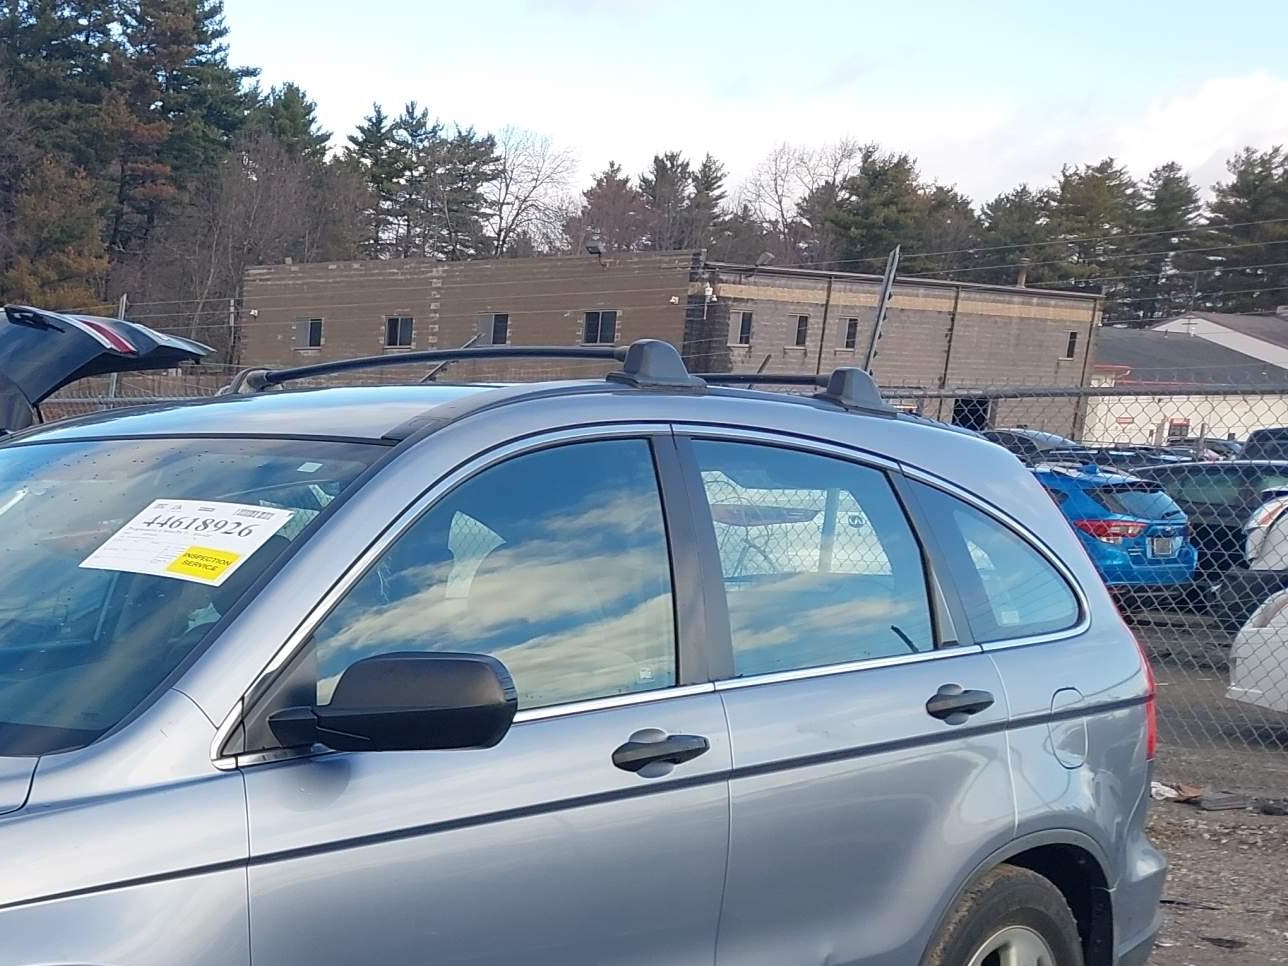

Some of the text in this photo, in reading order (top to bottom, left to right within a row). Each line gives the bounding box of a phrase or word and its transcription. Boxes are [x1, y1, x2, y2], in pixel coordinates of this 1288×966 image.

[143, 514, 260, 537] 44618926
[181, 559, 219, 572] SERVICE
[183, 552, 233, 567] INSPECTION
